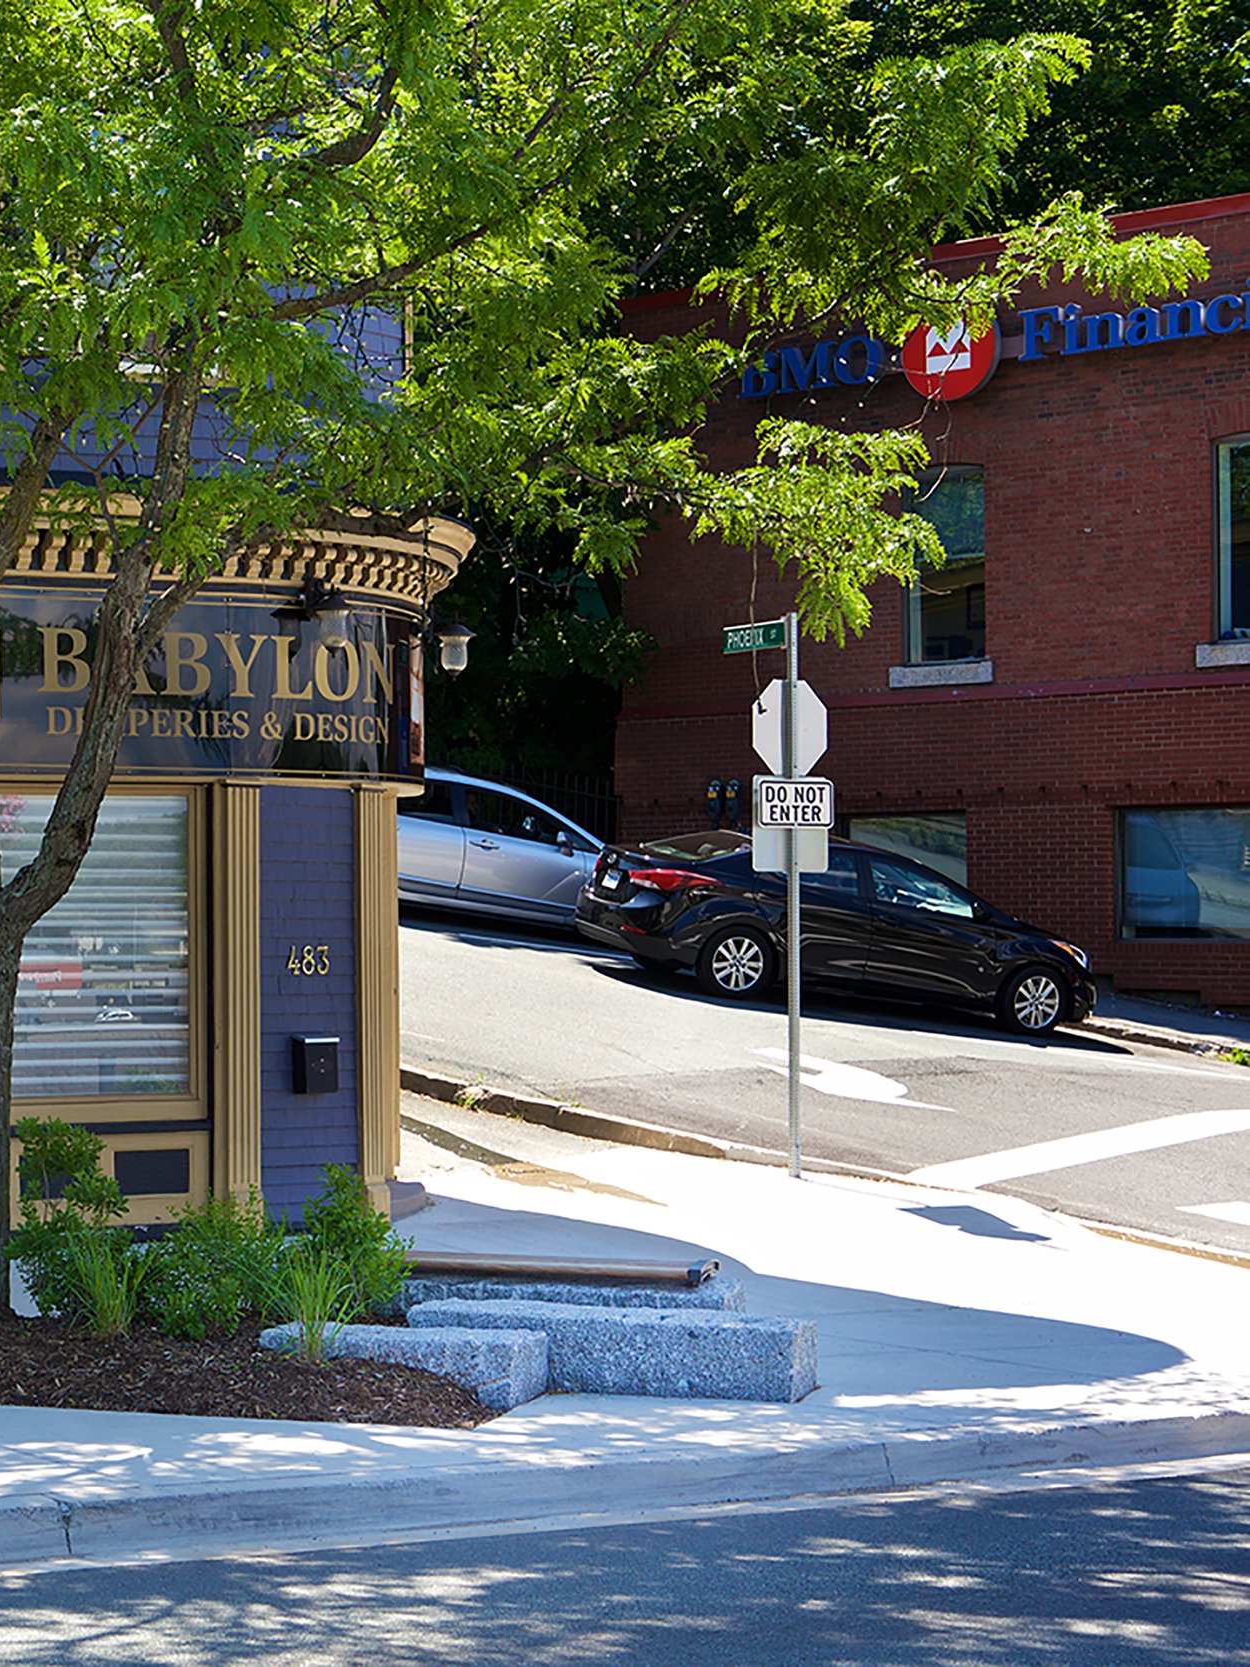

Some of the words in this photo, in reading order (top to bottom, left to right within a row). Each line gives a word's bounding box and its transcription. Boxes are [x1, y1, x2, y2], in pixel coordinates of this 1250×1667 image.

[737, 336, 882, 399] BMO
[46, 706, 251, 740] DPERIES
[260, 711, 284, 741] &
[294, 712, 390, 745] DESIGN
[765, 785, 788, 803] DO
[794, 786, 826, 804] NOT
[769, 804, 822, 822] ENTER
[287, 945, 330, 975] 483
